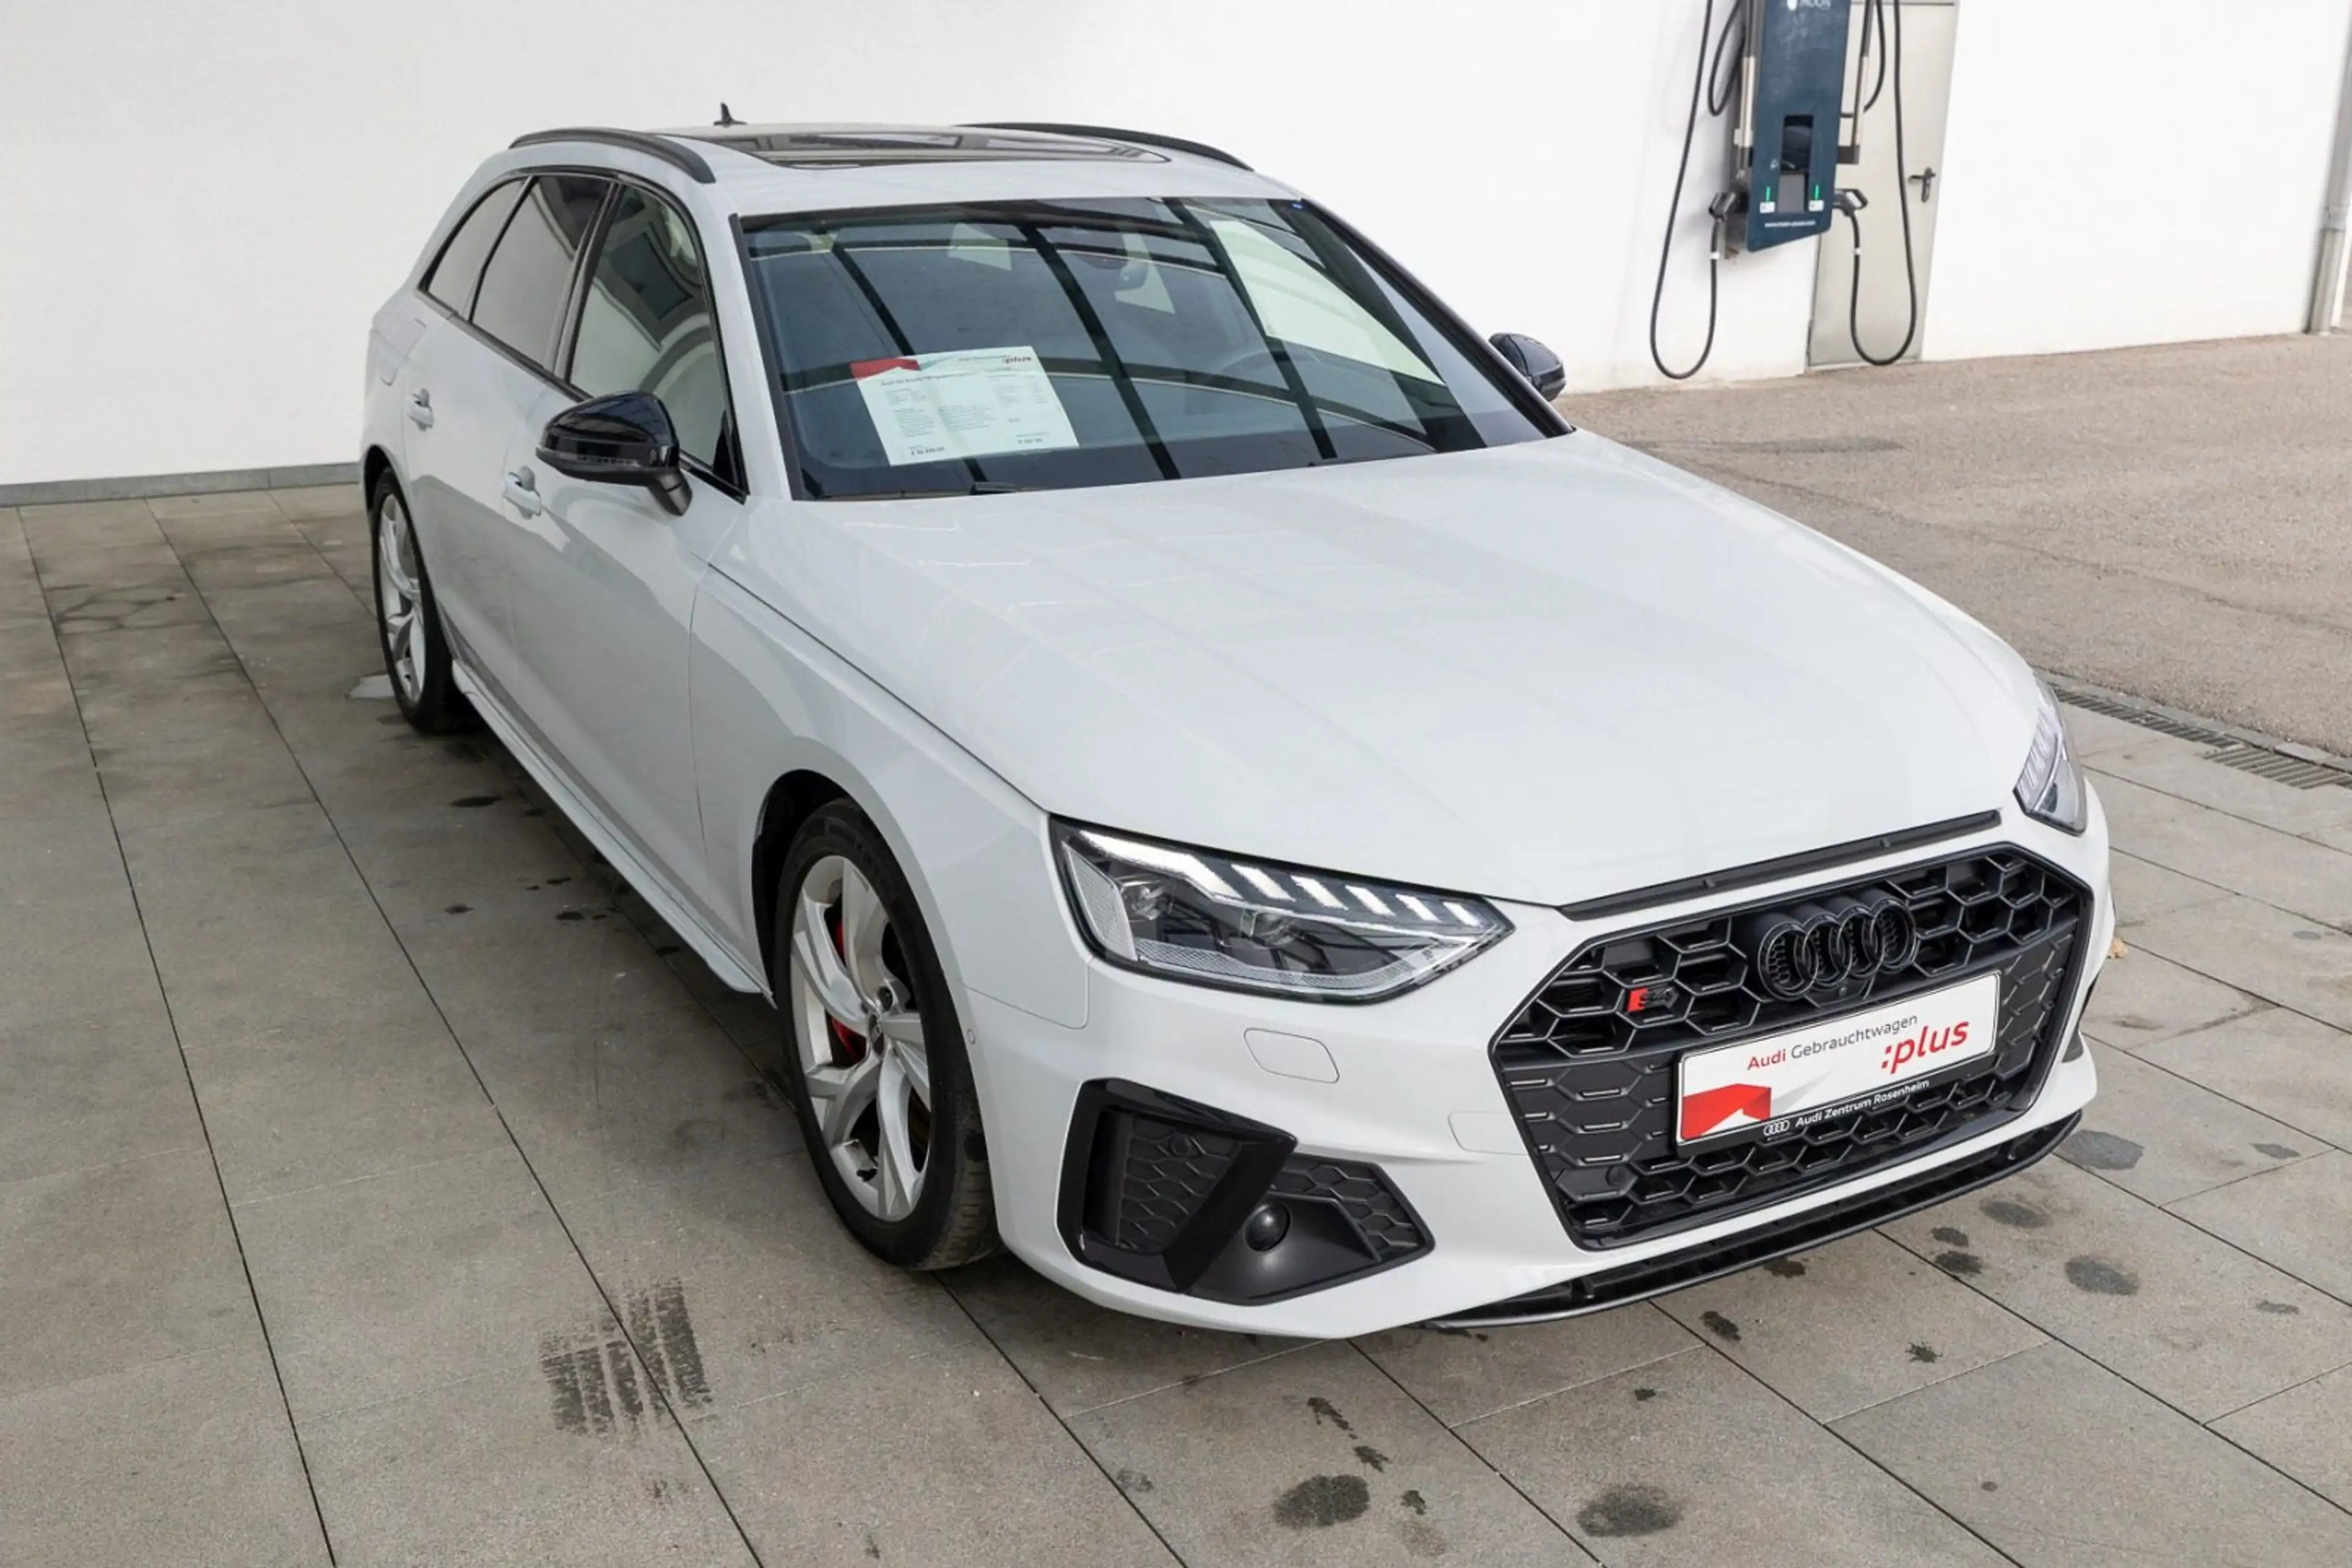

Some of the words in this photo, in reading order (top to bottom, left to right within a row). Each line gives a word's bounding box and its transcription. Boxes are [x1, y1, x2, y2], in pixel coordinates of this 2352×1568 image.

[1747, 1049, 1786, 1071] Audi
[1791, 1014, 1918, 1059] Gebrauchtwagen
[1881, 1021, 1969, 1074] :plus
[1795, 1111, 1822, 1128] Audi
[1824, 1098, 1872, 1119] Zentrum
[1873, 1079, 1930, 1107] Rosenheim
